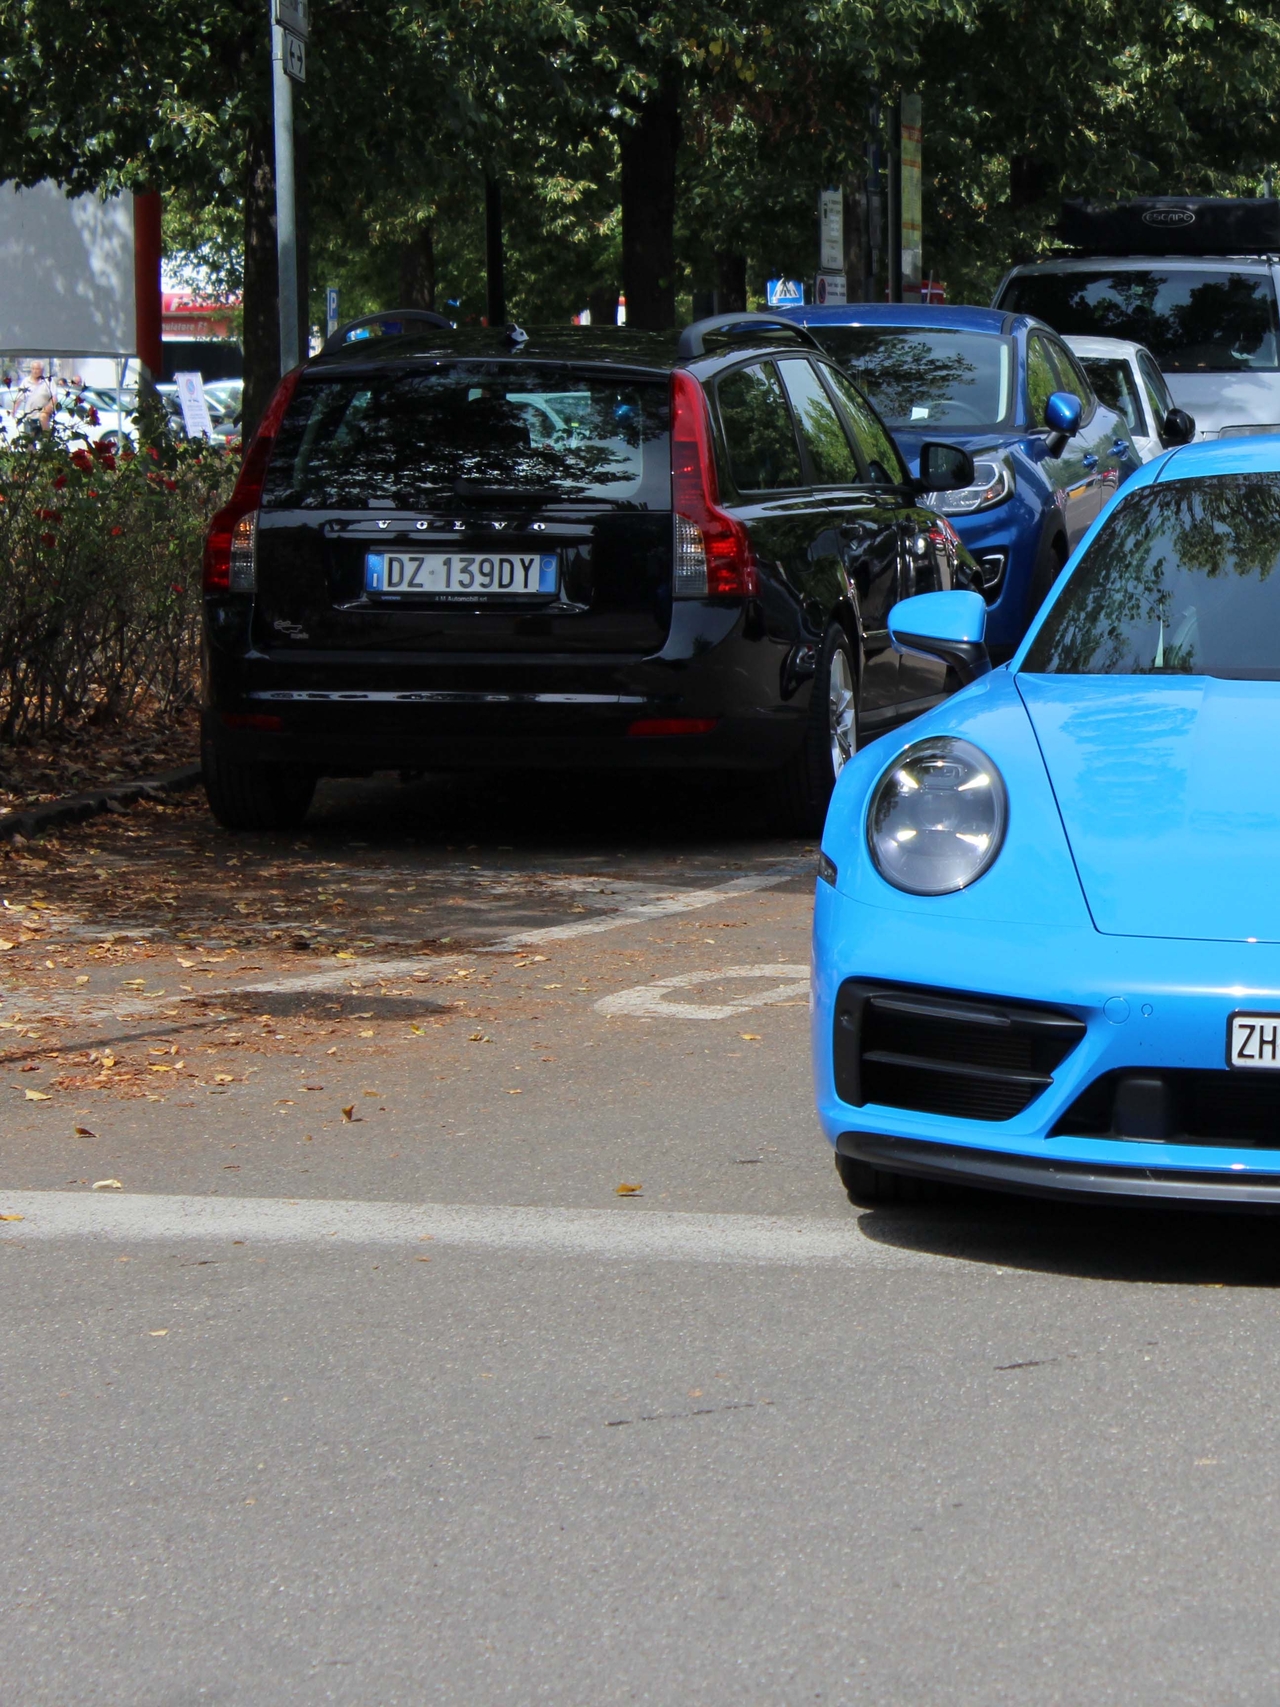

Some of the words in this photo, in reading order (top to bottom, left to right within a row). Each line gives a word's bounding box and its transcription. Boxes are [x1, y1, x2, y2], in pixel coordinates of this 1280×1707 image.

[331, 292, 337, 316] P
[376, 520, 546, 530] VOLVO
[387, 556, 425, 588] DZ
[442, 557, 535, 589] 139DY
